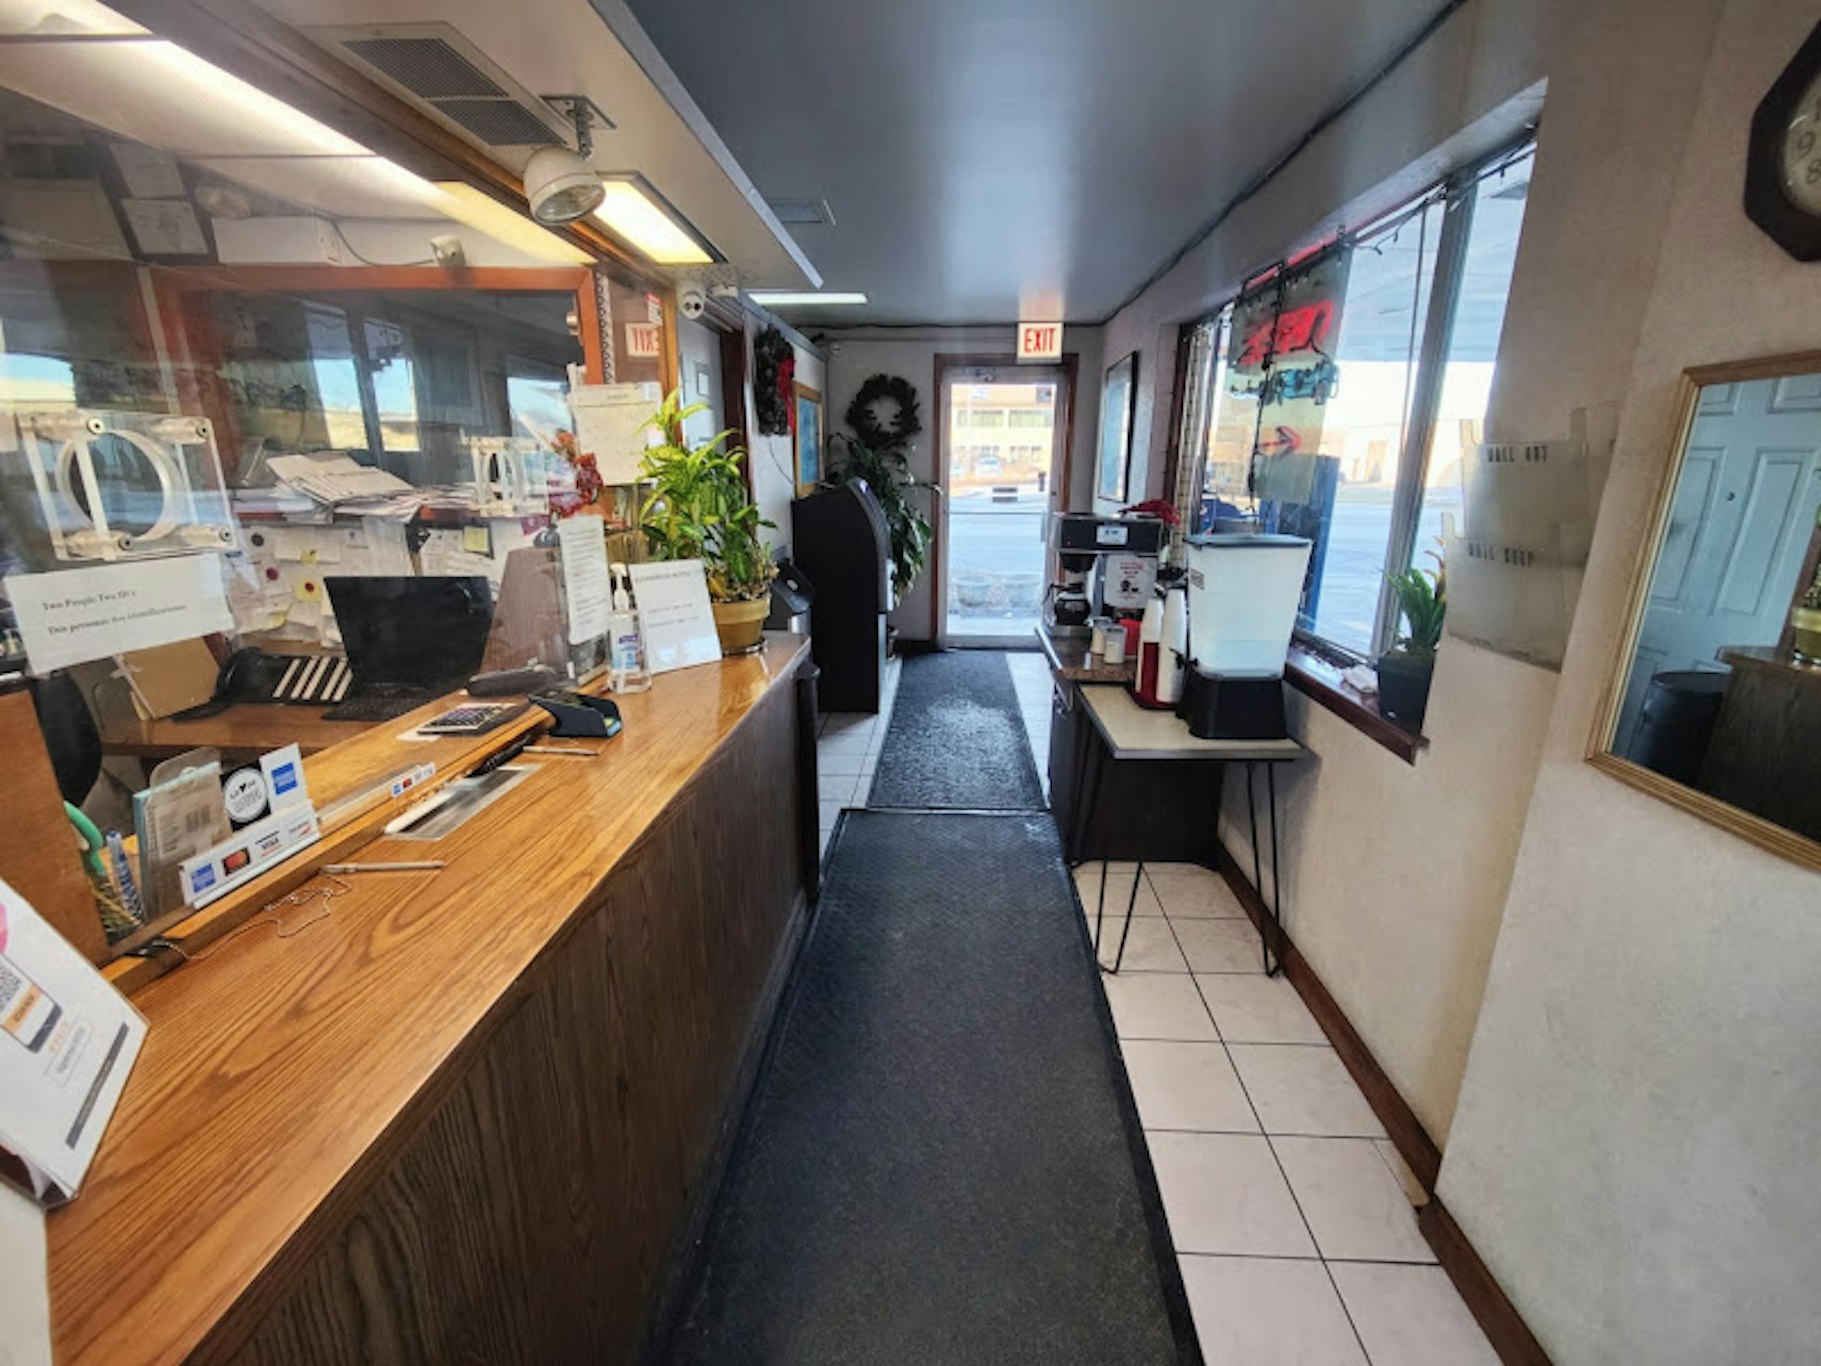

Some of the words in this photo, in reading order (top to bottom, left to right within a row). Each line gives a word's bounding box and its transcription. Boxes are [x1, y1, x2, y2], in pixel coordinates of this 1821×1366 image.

[1798, 131, 1816, 160] 9
[1806, 158, 1821, 185] 8
[1024, 327, 1056, 352] EXIT
